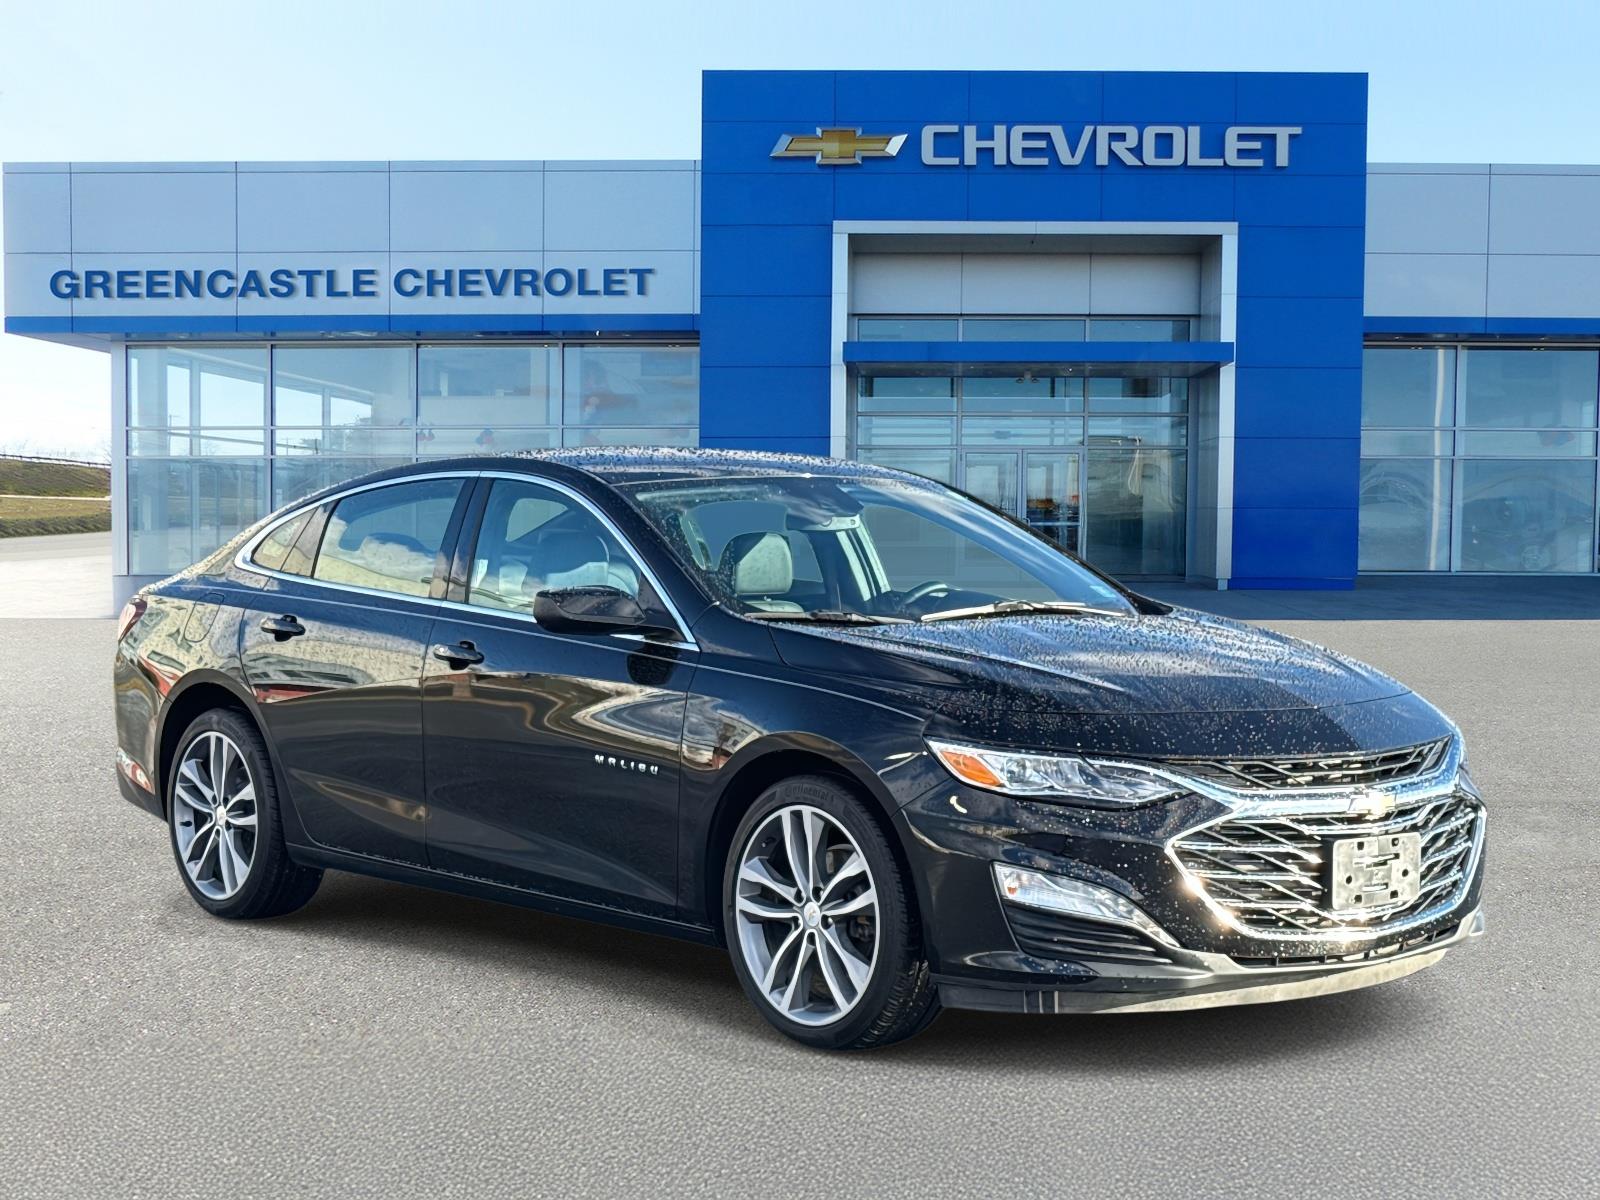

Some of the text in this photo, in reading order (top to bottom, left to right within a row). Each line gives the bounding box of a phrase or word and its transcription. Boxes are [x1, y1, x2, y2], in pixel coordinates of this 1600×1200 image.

[921, 124, 1302, 167] CHEVROLET
[50, 268, 654, 299] GREENCASTLE CHEVROLET
[594, 754, 659, 775] MALIBU
